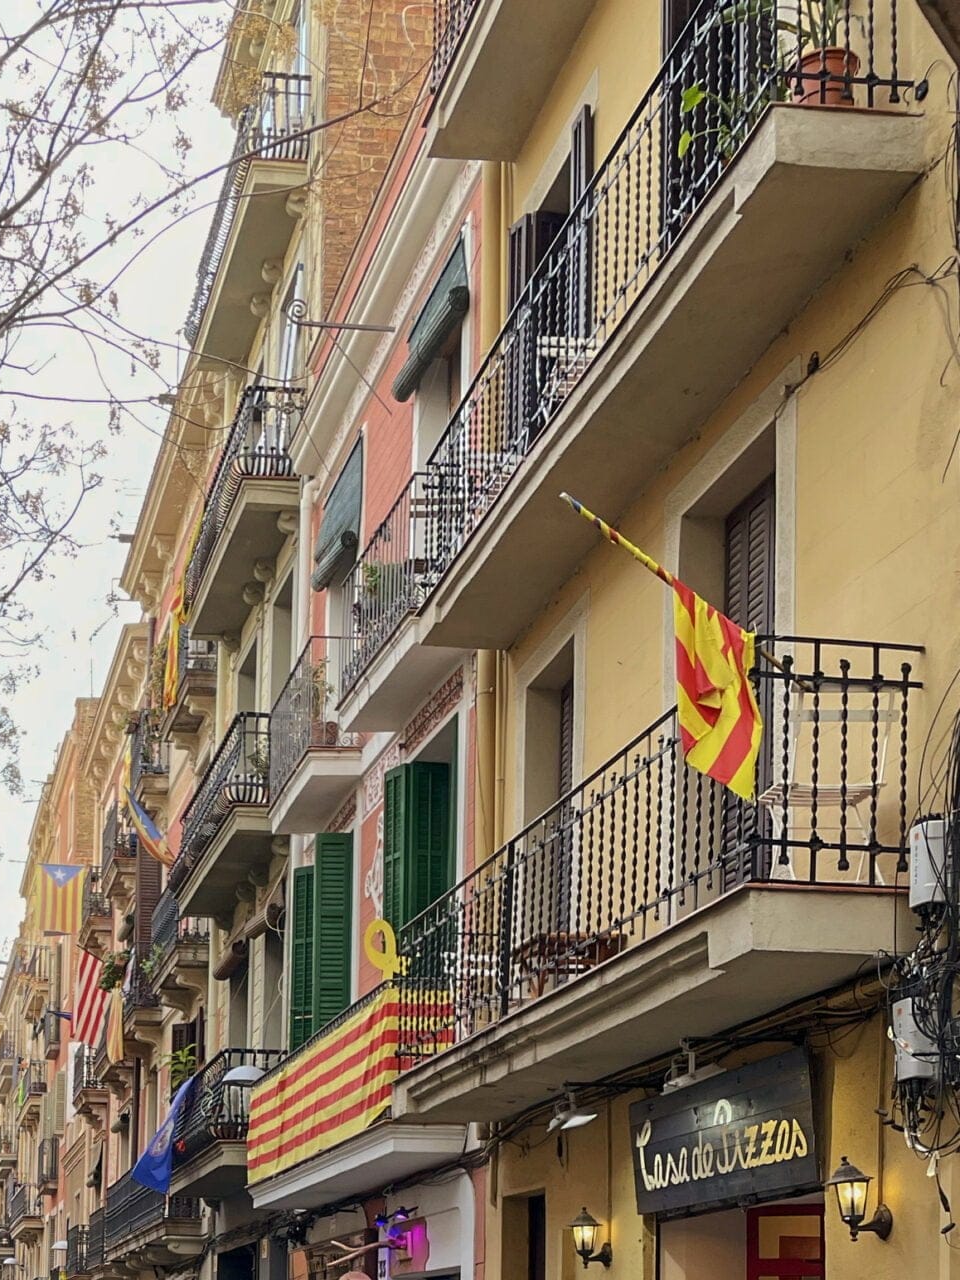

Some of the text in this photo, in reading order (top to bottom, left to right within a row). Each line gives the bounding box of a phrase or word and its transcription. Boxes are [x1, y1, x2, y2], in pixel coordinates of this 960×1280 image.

[636, 1098, 808, 1191] Casa de Pizzas
